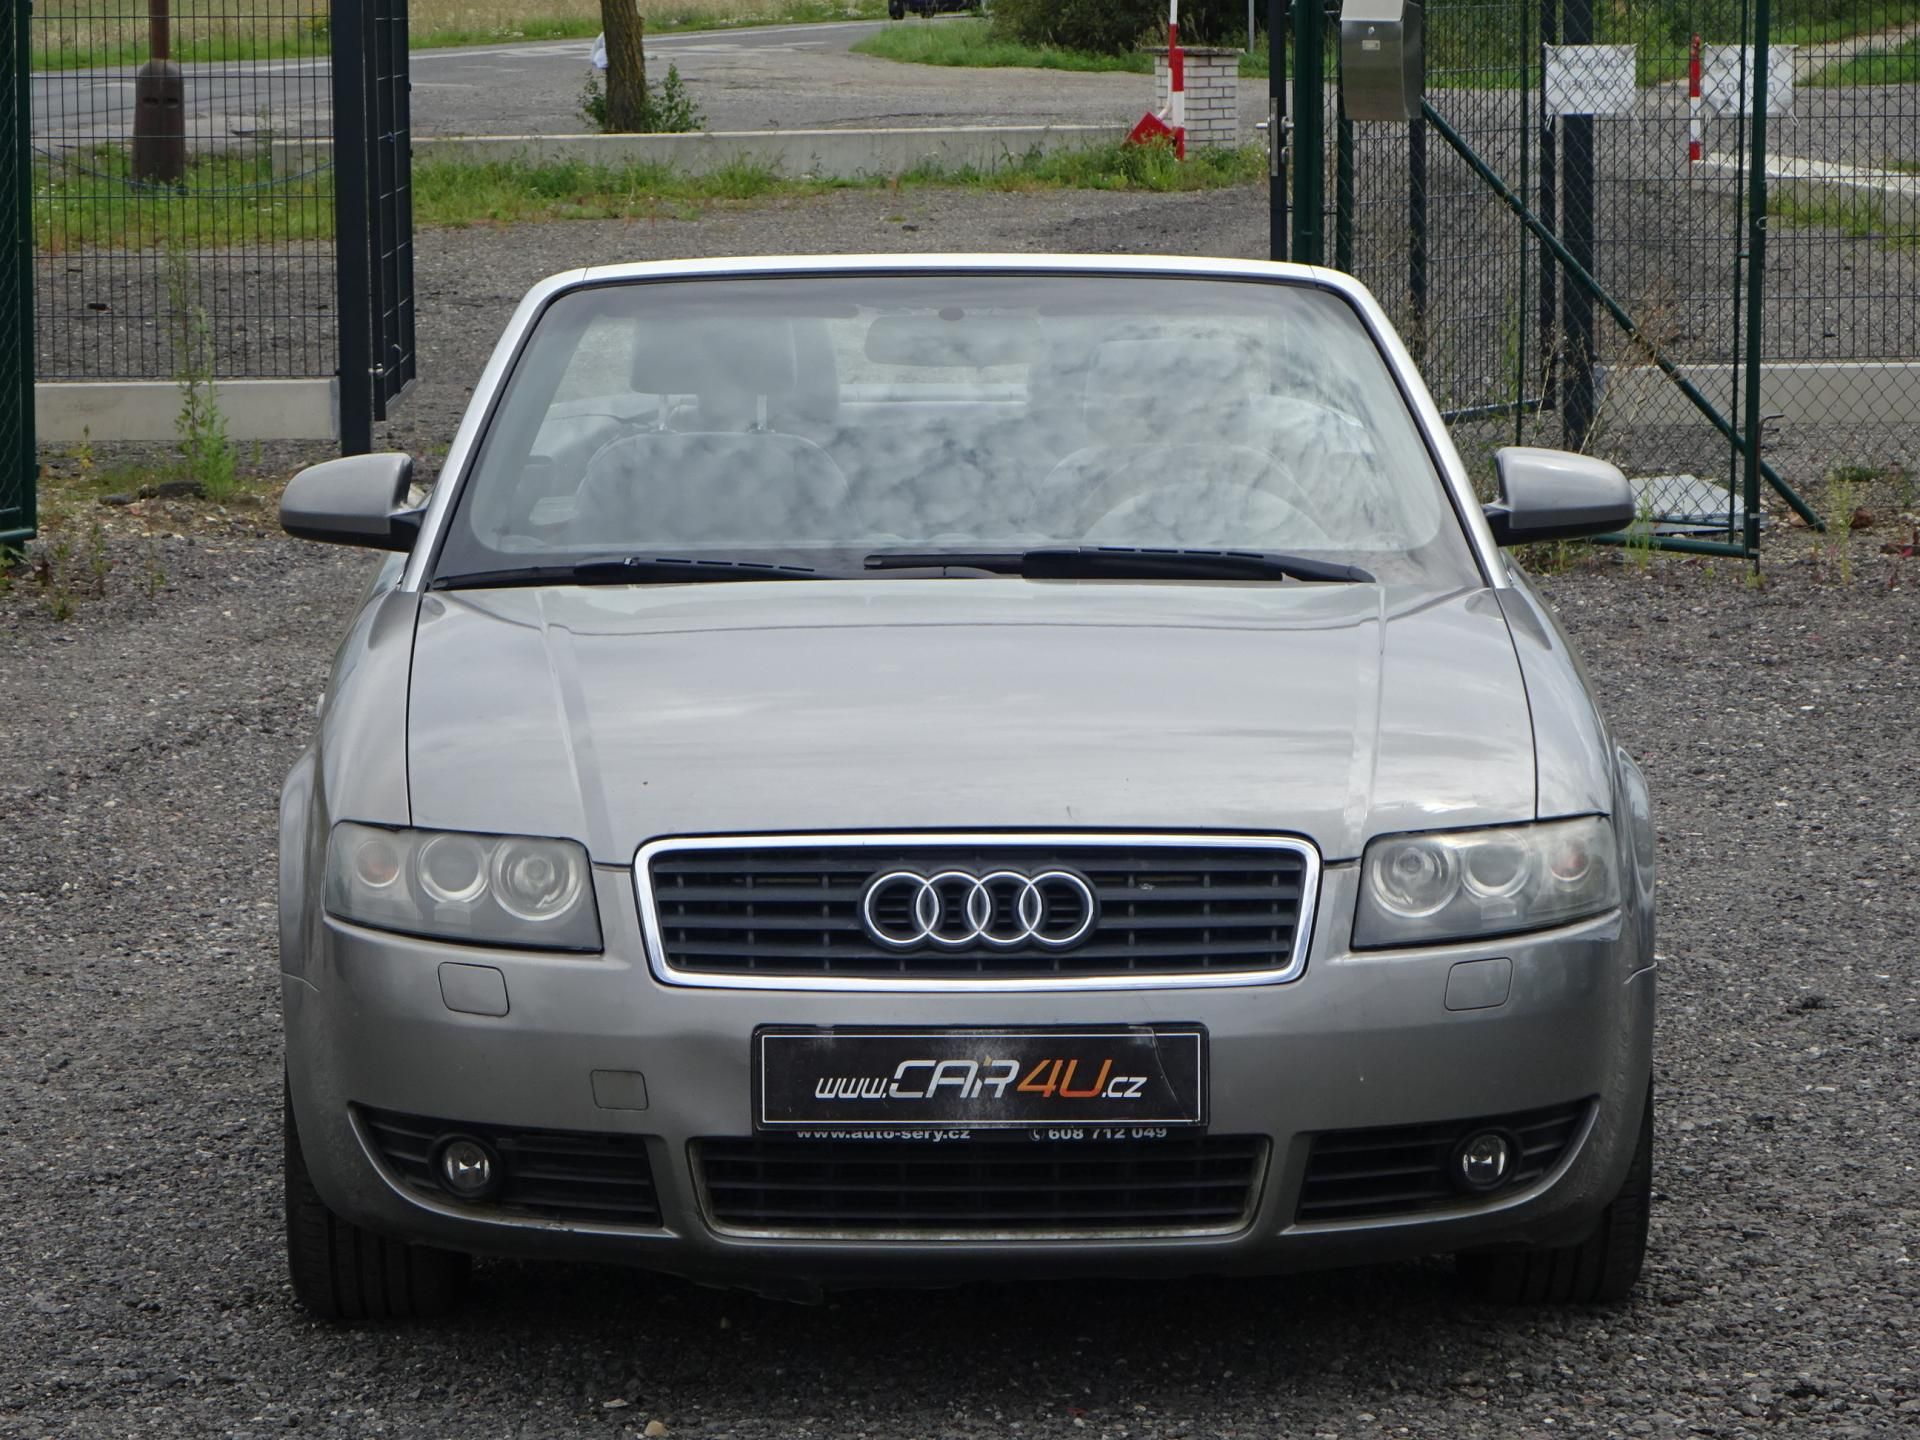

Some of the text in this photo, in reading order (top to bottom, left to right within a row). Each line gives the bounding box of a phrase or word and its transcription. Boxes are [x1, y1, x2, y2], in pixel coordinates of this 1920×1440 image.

[797, 1130, 971, 1142] www.auto-sery.cz
[1048, 1127, 1167, 1140] 608 712 049
